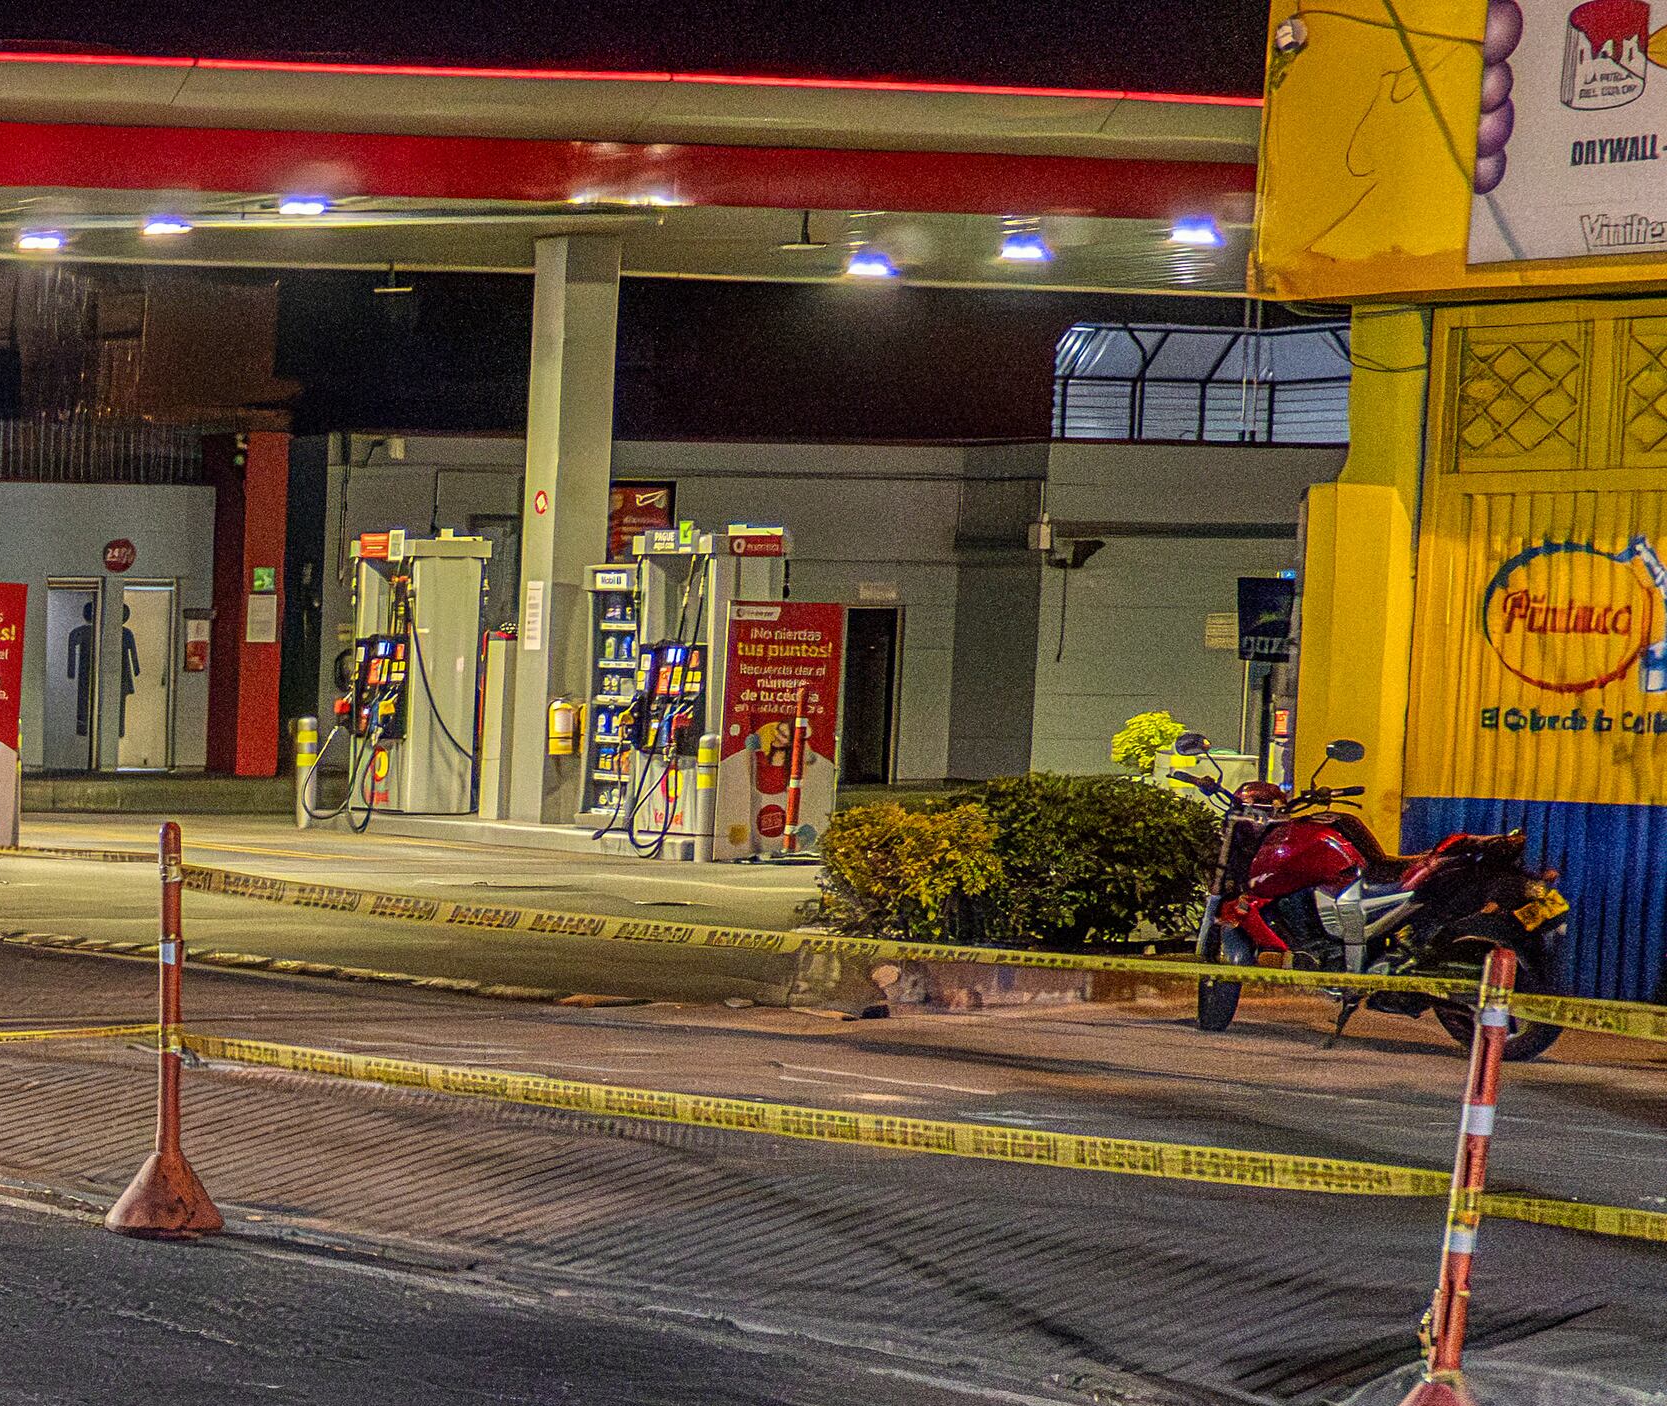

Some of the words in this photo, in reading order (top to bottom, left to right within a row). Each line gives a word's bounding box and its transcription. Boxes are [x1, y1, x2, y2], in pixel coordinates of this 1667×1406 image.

[1570, 134, 1659, 167] DRYWALL
[1579, 213, 1667, 252] Vinilte
[737, 641, 765, 657] tus
